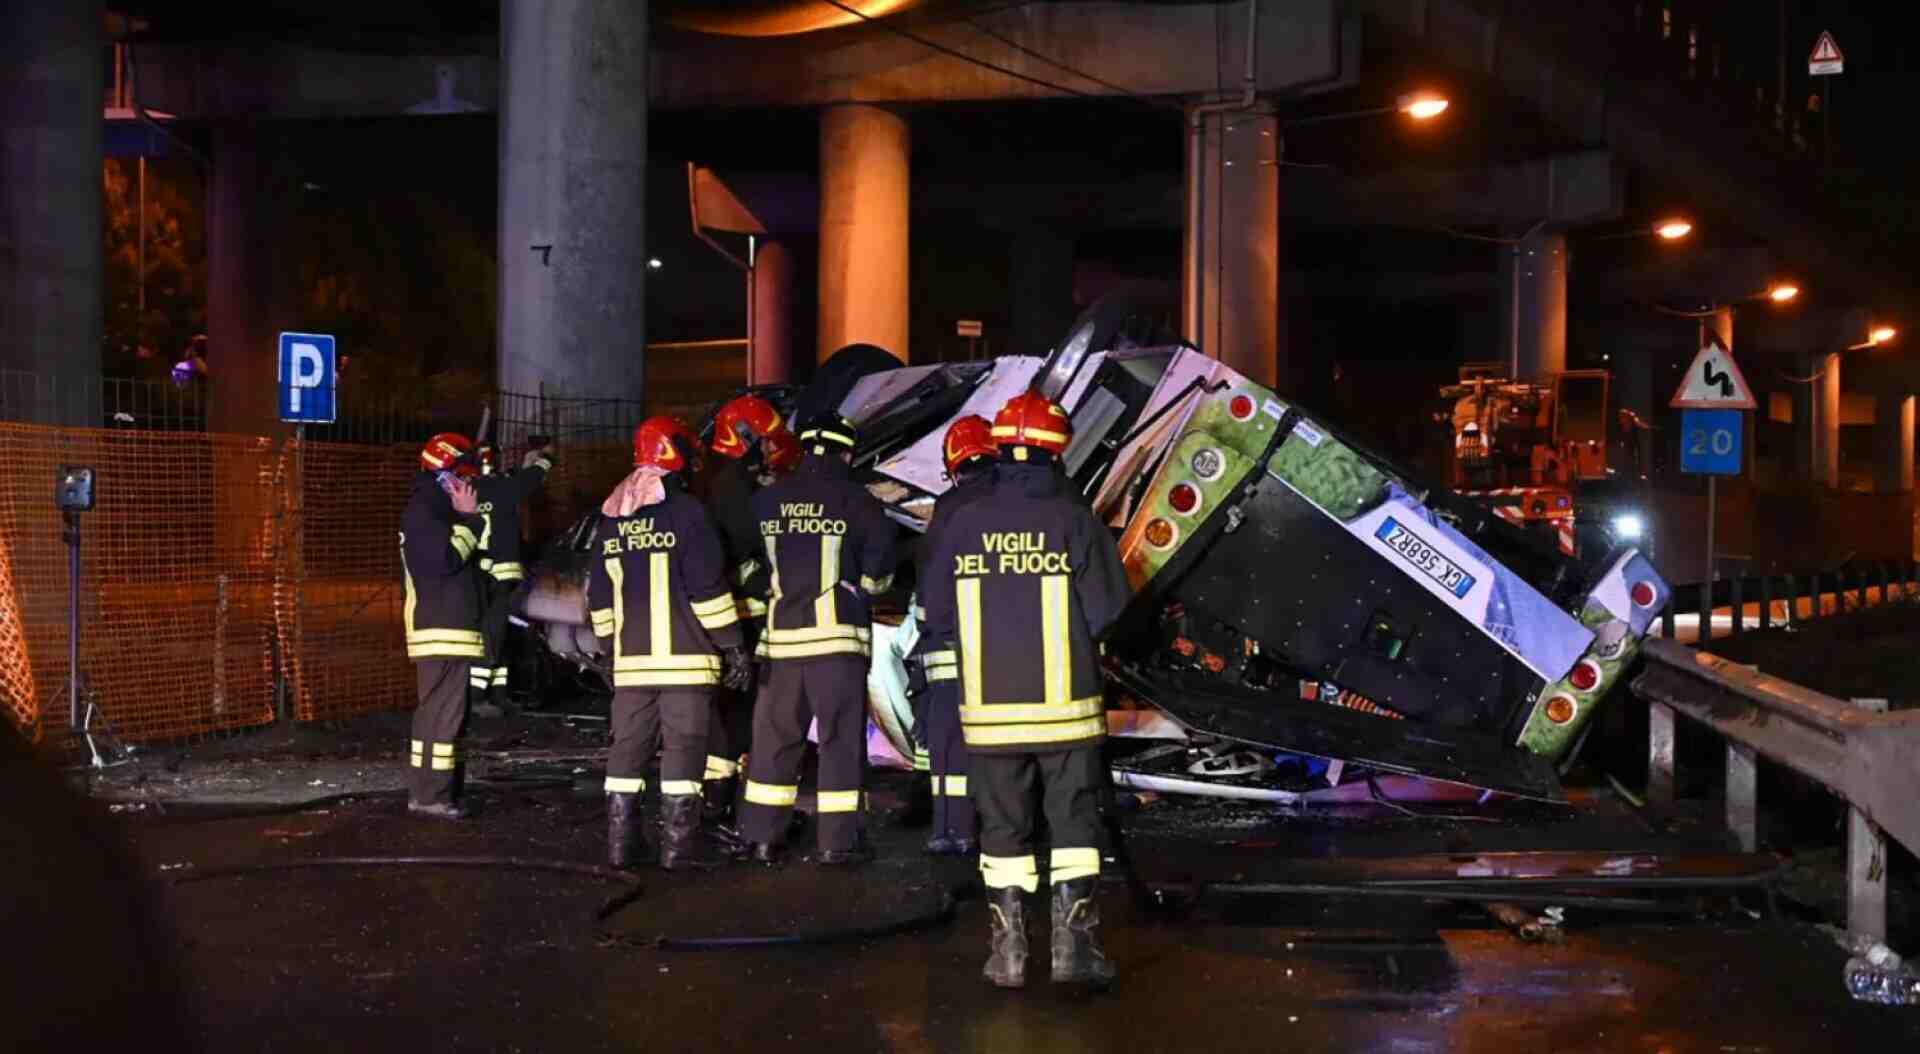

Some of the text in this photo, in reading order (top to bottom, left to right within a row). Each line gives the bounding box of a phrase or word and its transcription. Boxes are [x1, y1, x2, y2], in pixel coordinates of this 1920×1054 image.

[291, 342, 324, 413] P
[1688, 429, 1734, 456] 20
[780, 503, 824, 518] VIGILI
[760, 518, 847, 536] DEL FUOCO
[982, 532, 1045, 552] VIGILI
